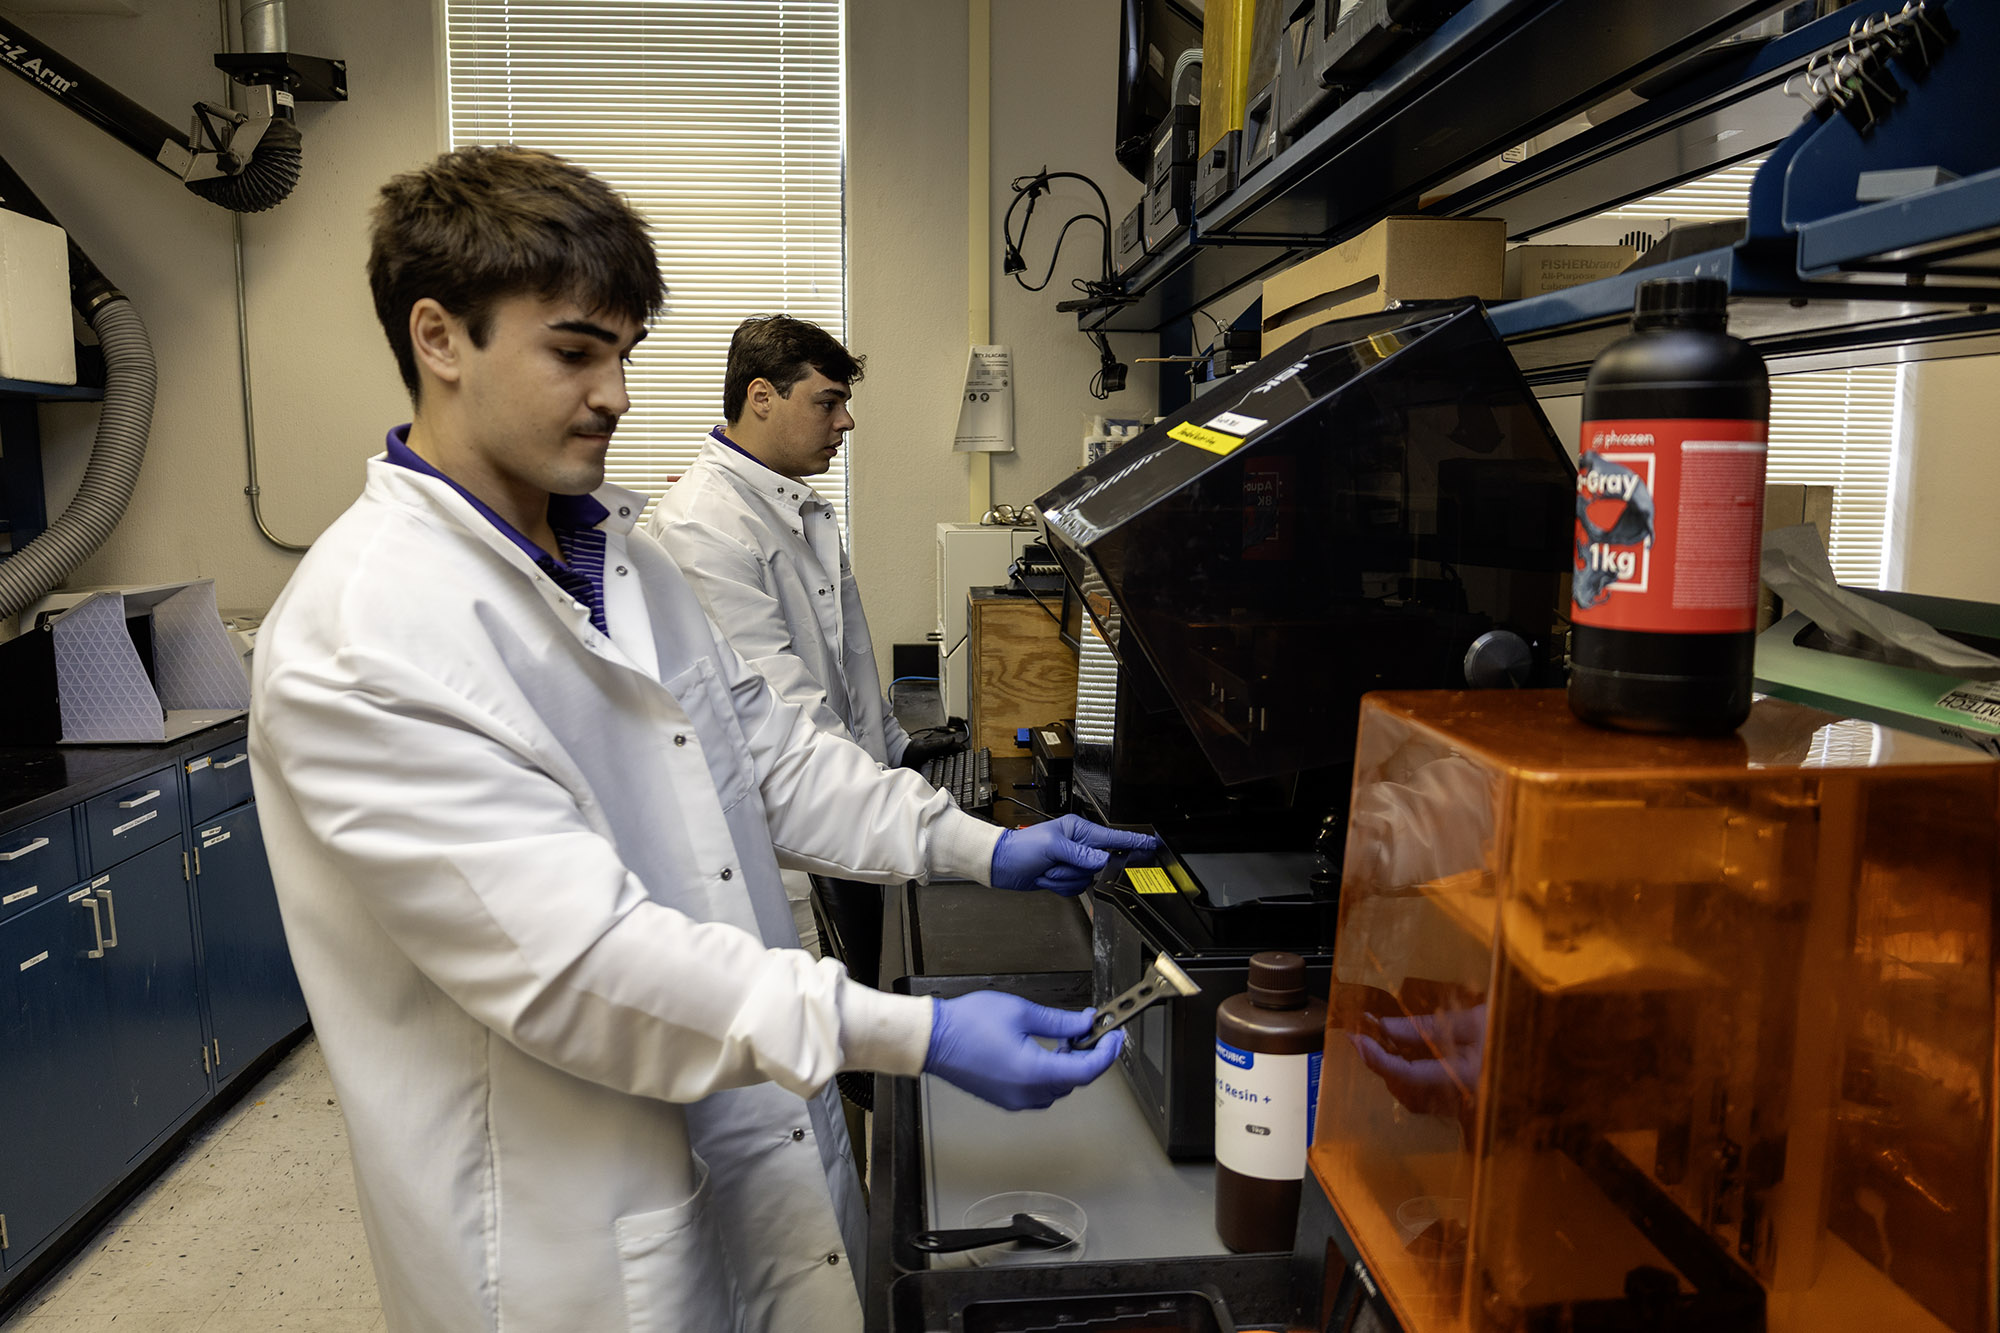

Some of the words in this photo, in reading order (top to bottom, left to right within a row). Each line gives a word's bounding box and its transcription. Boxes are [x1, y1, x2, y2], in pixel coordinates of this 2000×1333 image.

[1541, 258, 1623, 270] FISHERbrand
[1604, 429, 1655, 449] phrozen
[1589, 543, 1636, 580] 1kg
[1225, 1083, 1258, 1103] Resin
